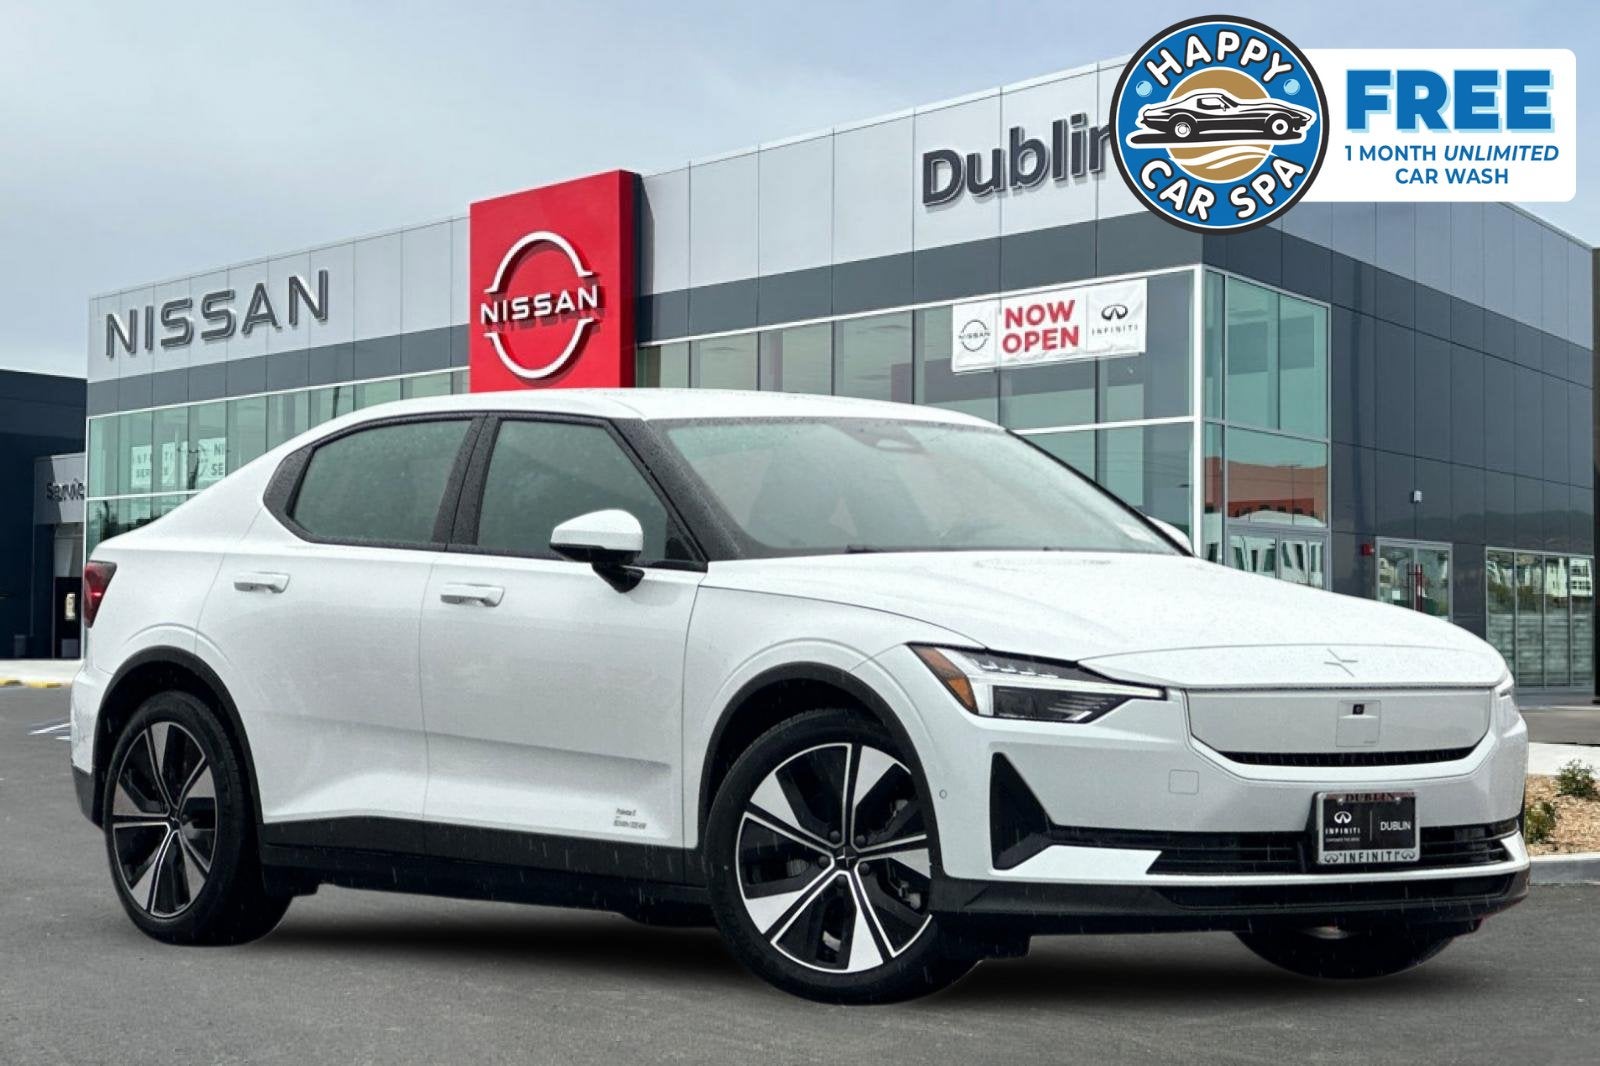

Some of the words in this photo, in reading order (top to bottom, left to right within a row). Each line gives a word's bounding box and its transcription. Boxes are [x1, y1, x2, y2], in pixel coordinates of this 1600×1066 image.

[105, 269, 329, 358] NISSAN
[480, 285, 598, 325] NISSAN
[1004, 299, 1076, 330] NOW
[1002, 326, 1080, 354] OPEN
[1325, 827, 1361, 835] INFINITI
[1380, 821, 1411, 831] DUBLIN
[1343, 851, 1400, 864] INFINITI
